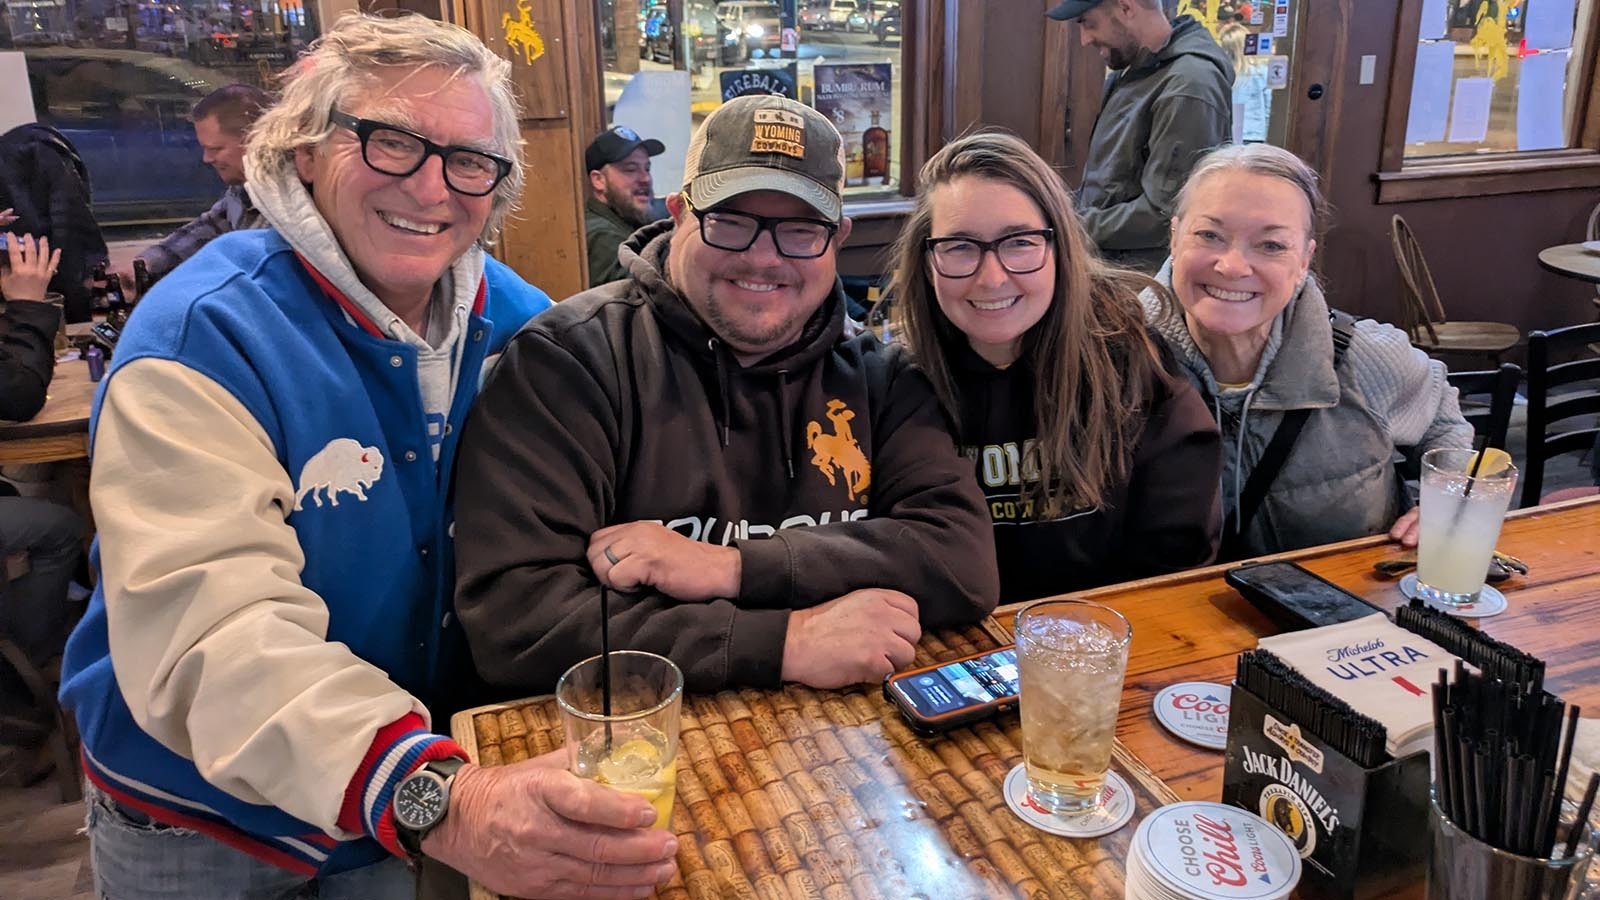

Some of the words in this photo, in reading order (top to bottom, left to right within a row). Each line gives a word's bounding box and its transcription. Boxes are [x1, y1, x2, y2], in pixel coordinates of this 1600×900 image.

[860, 81, 885, 92] RUM
[754, 125, 801, 142] WYOMING
[756, 141, 798, 154] COWBOYS
[1326, 638, 1385, 662] Michelob
[1326, 646, 1429, 680] ULTRA
[1170, 693, 1231, 714] Coo
[1183, 711, 1227, 724] LIG
[1242, 745, 1279, 779] JACK
[1243, 822, 1259, 846] LIGHT
[1174, 819, 1201, 877] CHOOSE
[1193, 813, 1248, 887] Chill
[1251, 845, 1268, 873] Coors
